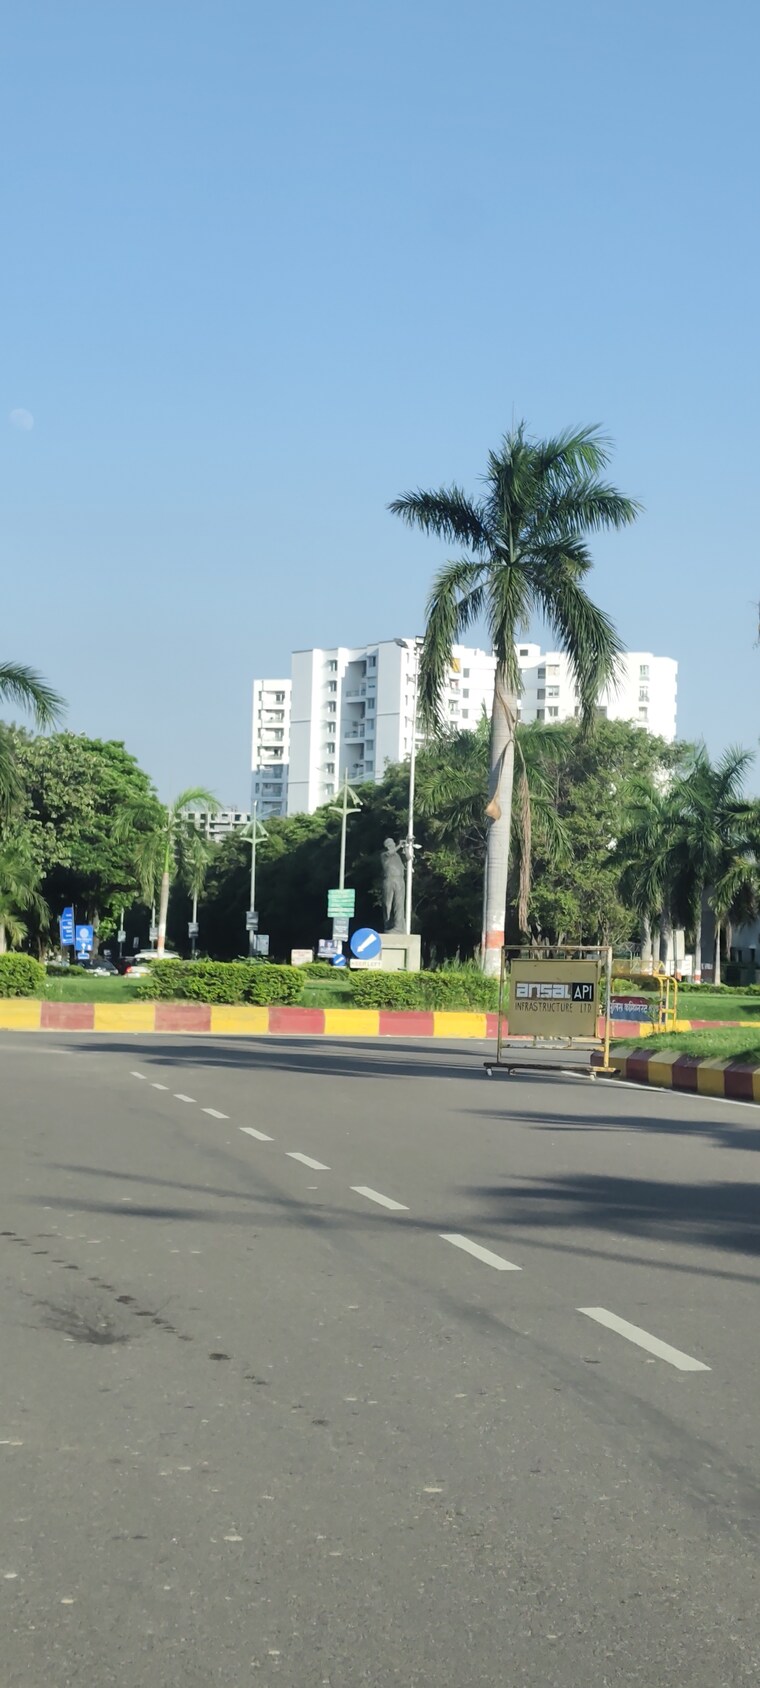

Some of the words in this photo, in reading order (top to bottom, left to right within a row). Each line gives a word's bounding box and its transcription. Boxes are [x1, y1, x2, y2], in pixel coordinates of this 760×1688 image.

[573, 985, 592, 1000] API
[515, 1002, 573, 1013] INFRASTRUCTURE
[580, 1003, 592, 1014] LTD
